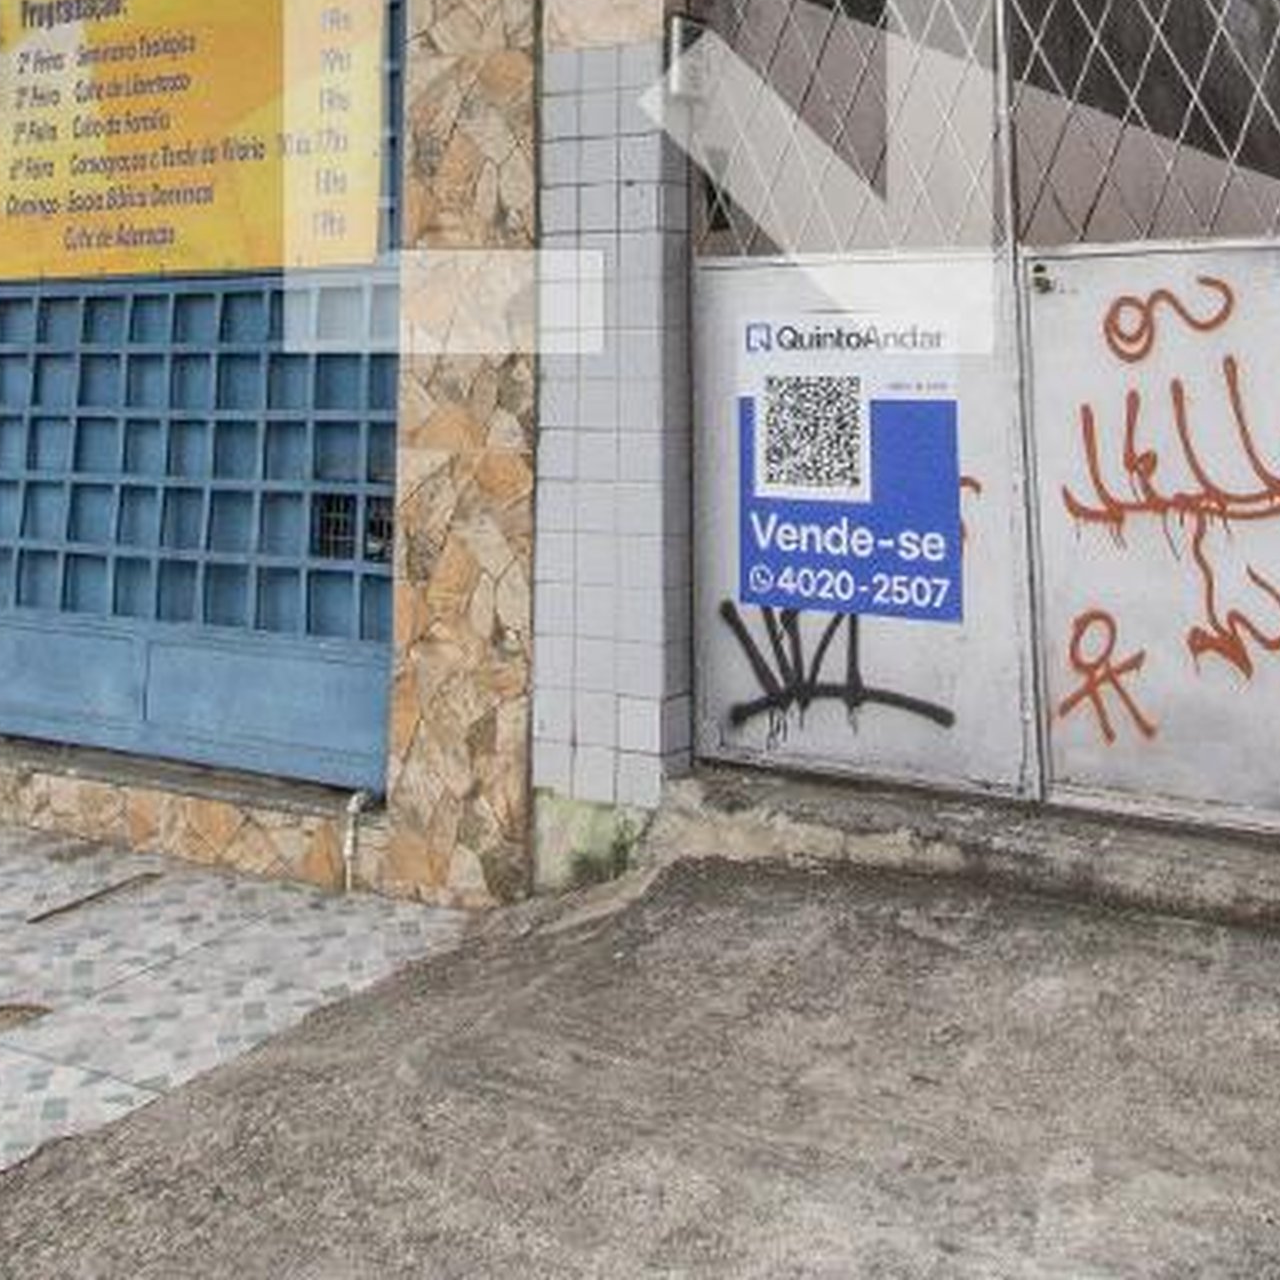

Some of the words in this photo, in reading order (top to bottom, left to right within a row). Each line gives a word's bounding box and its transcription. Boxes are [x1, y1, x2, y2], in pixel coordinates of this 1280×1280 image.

[776, 324, 944, 351] QuintoAndar
[749, 511, 947, 562] Vende-se
[776, 566, 951, 609] 4020-2507
